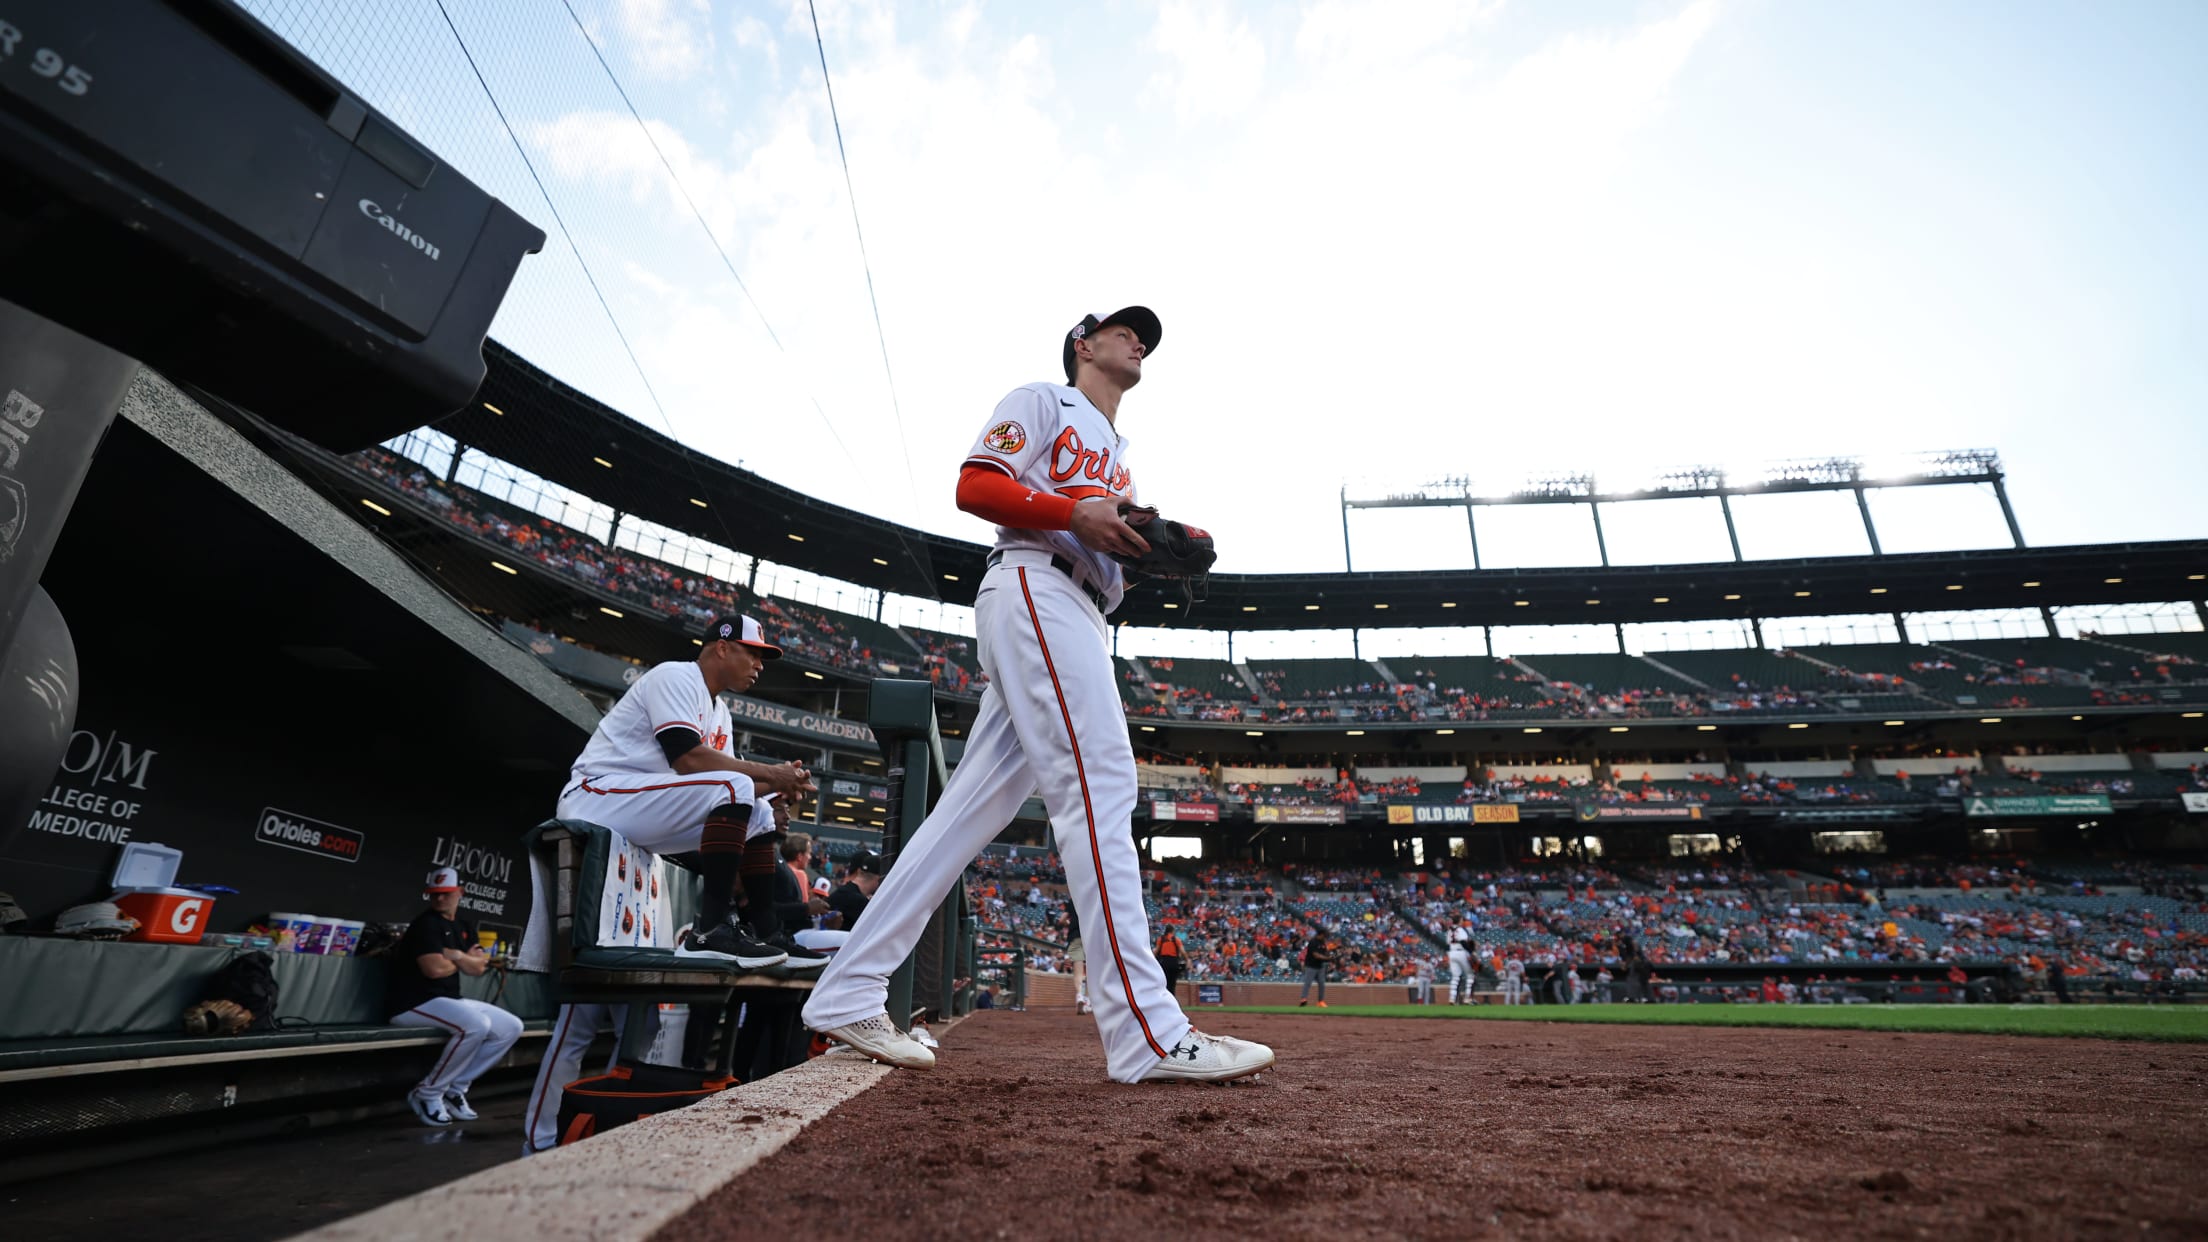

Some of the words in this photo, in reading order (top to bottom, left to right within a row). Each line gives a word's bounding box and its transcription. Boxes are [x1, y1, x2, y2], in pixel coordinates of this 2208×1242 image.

[30, 47, 93, 96] 95
[358, 199, 440, 260] Canon
[744, 702, 787, 726] PARK
[801, 714, 868, 742] CAMDEN
[28, 810, 132, 846] MEDICINE
[111, 800, 141, 820] OF
[1417, 807, 1442, 822] OLD
[1445, 806, 1470, 821] BAY
[1477, 806, 1515, 820] SEASON
[263, 815, 358, 856] Orioles.com
[464, 881, 497, 899] COLLEGE
[496, 889, 507, 901] OF
[472, 899, 505, 916] MEDICINE
[171, 900, 203, 934] G
[612, 893, 623, 940] GEICO
